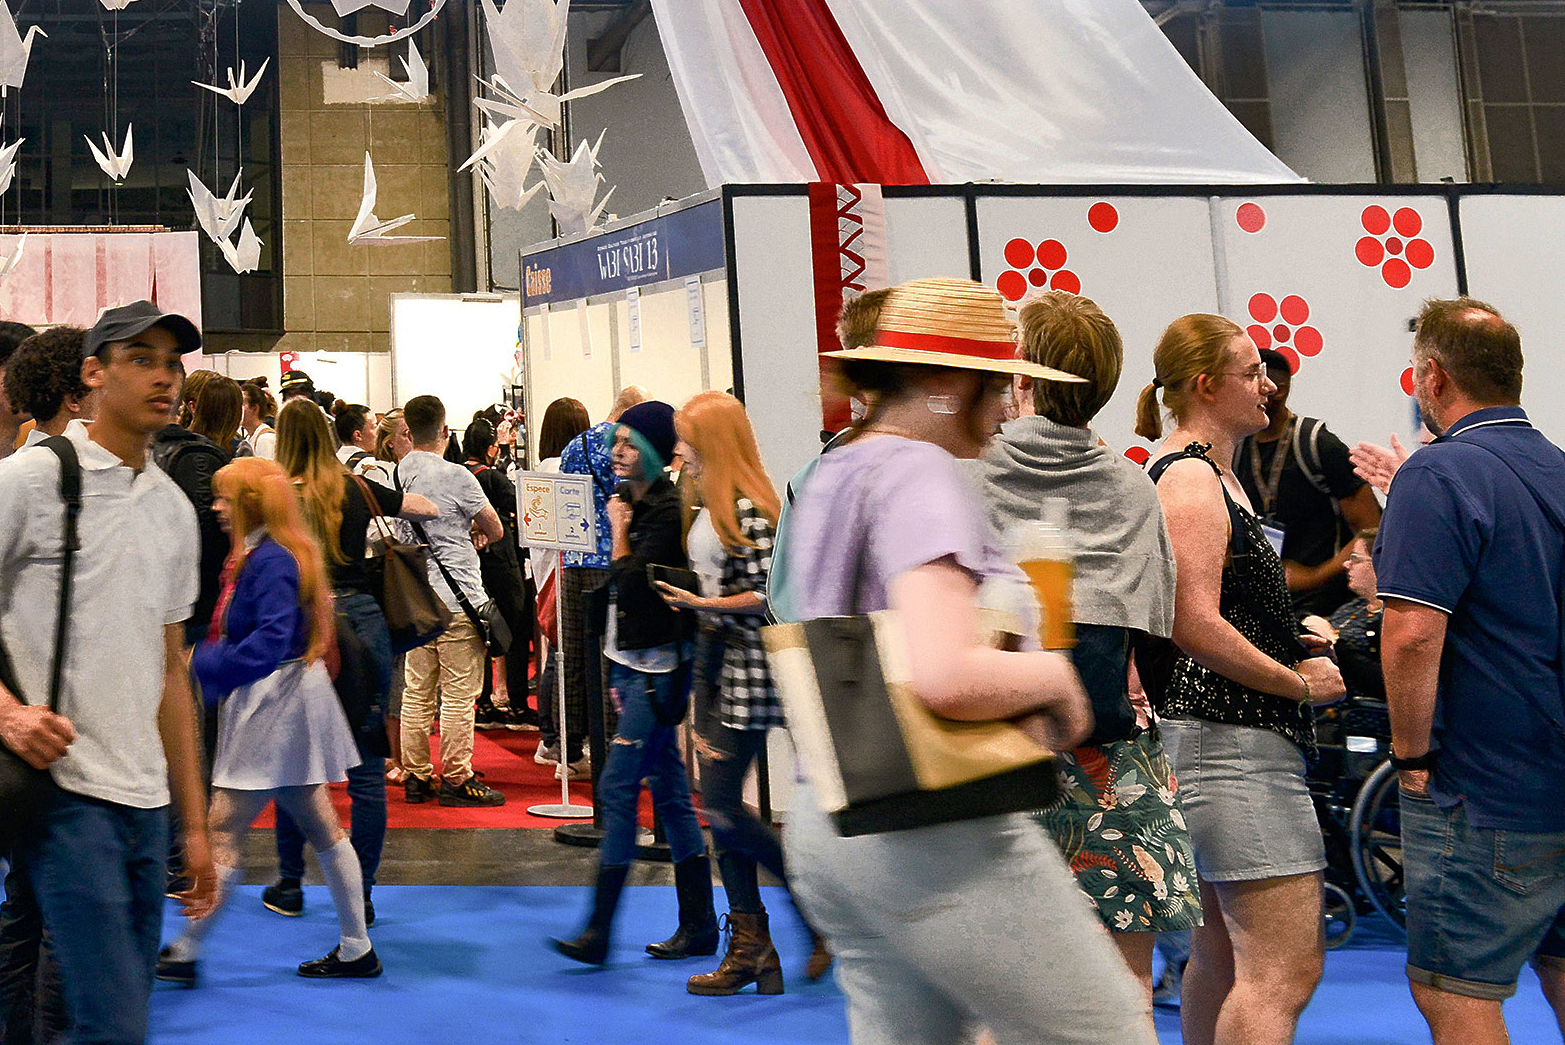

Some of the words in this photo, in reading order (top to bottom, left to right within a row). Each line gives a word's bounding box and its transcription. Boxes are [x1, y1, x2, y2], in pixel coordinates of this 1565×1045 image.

[646, 237, 659, 270] 13
[526, 263, 552, 297] Caisse
[526, 483, 550, 494] Espece
[560, 486, 580, 496] Carte
